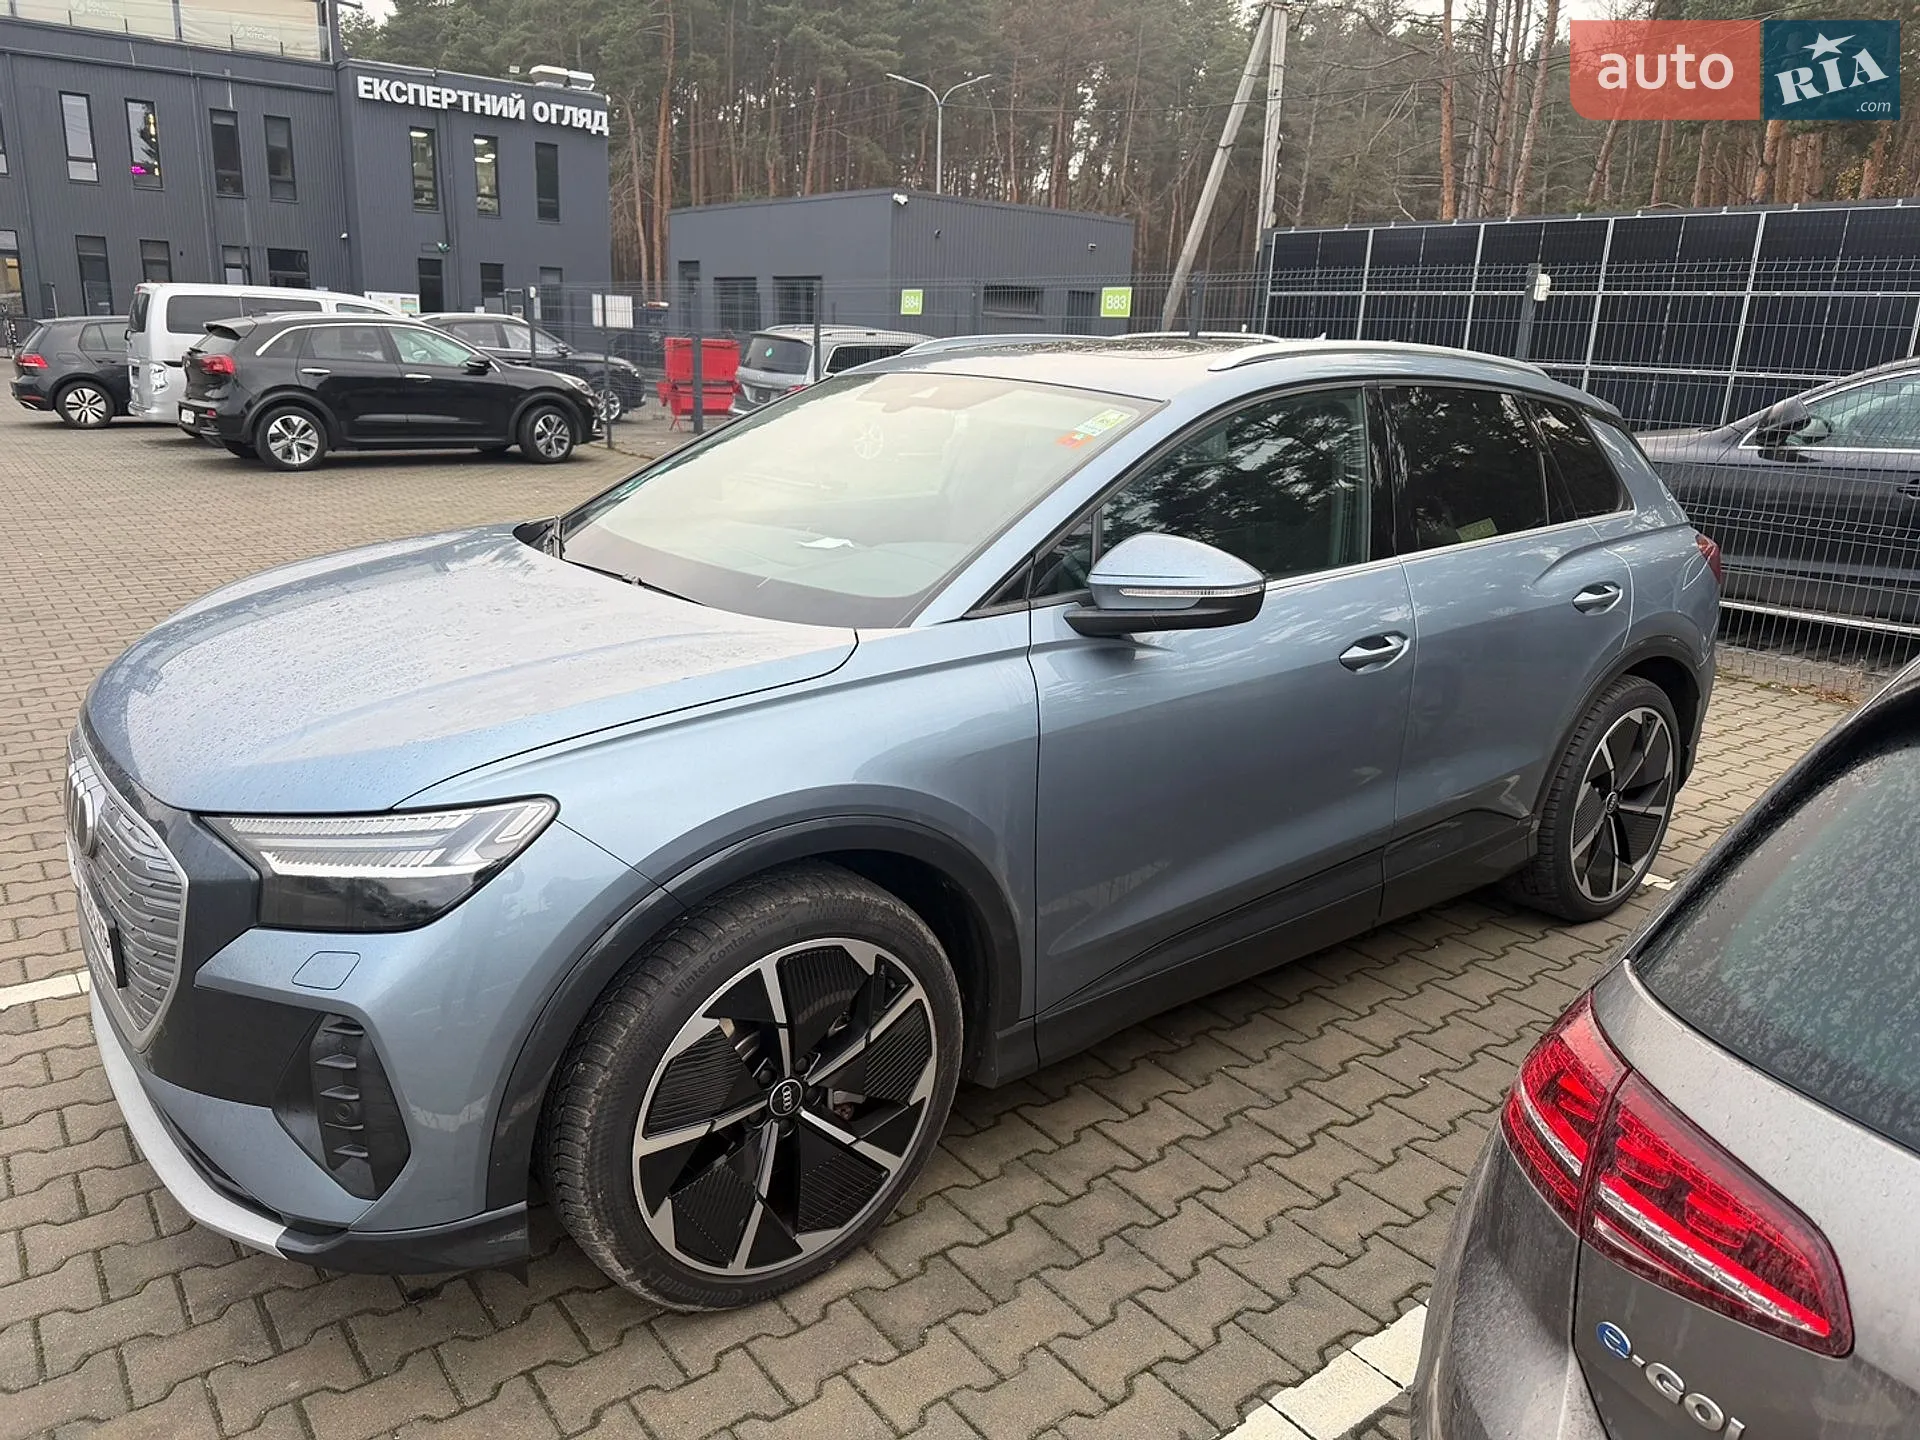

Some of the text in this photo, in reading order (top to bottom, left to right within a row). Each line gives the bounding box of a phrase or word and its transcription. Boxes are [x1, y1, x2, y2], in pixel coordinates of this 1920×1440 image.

[357, 75, 610, 137] ЕКСПЕРТНИЙ ОГЛЯД
[670, 924, 760, 999] WinterContact
